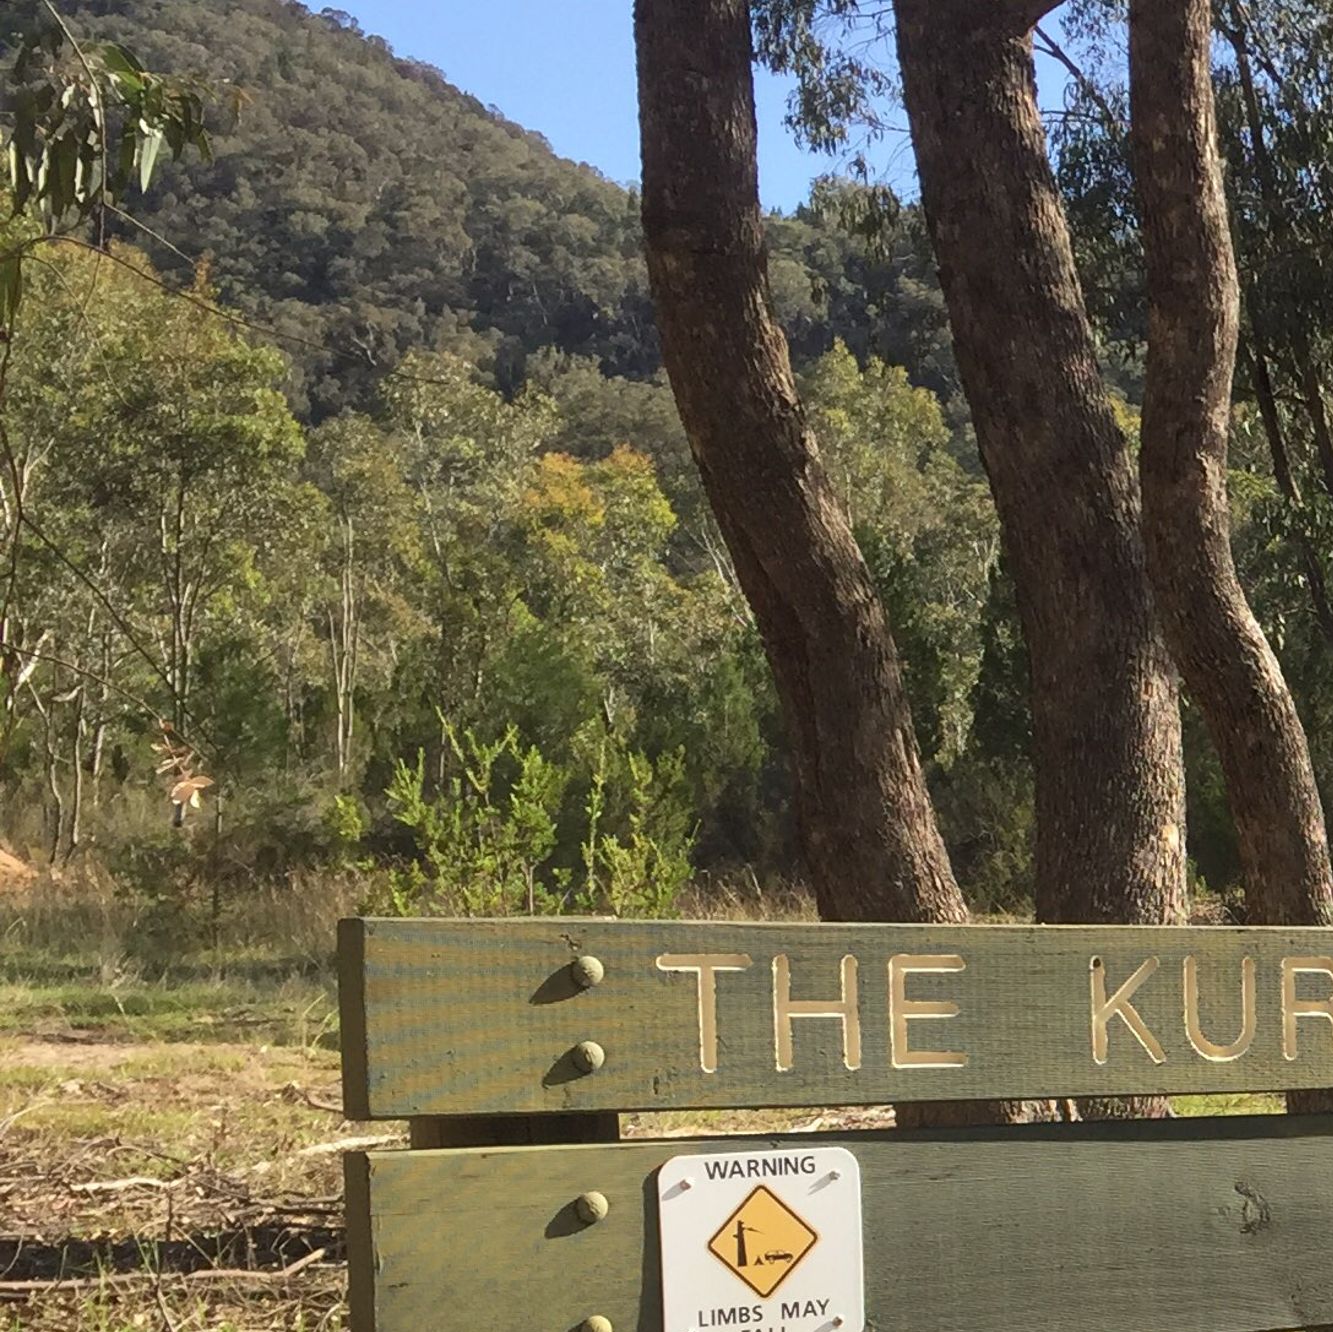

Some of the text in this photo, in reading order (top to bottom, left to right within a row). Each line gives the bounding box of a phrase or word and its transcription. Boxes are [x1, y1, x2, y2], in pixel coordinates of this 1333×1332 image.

[656, 953, 968, 1073] THE
[704, 1156, 816, 1180] WARNING
[698, 1299, 830, 1327] LIMBS MAY
